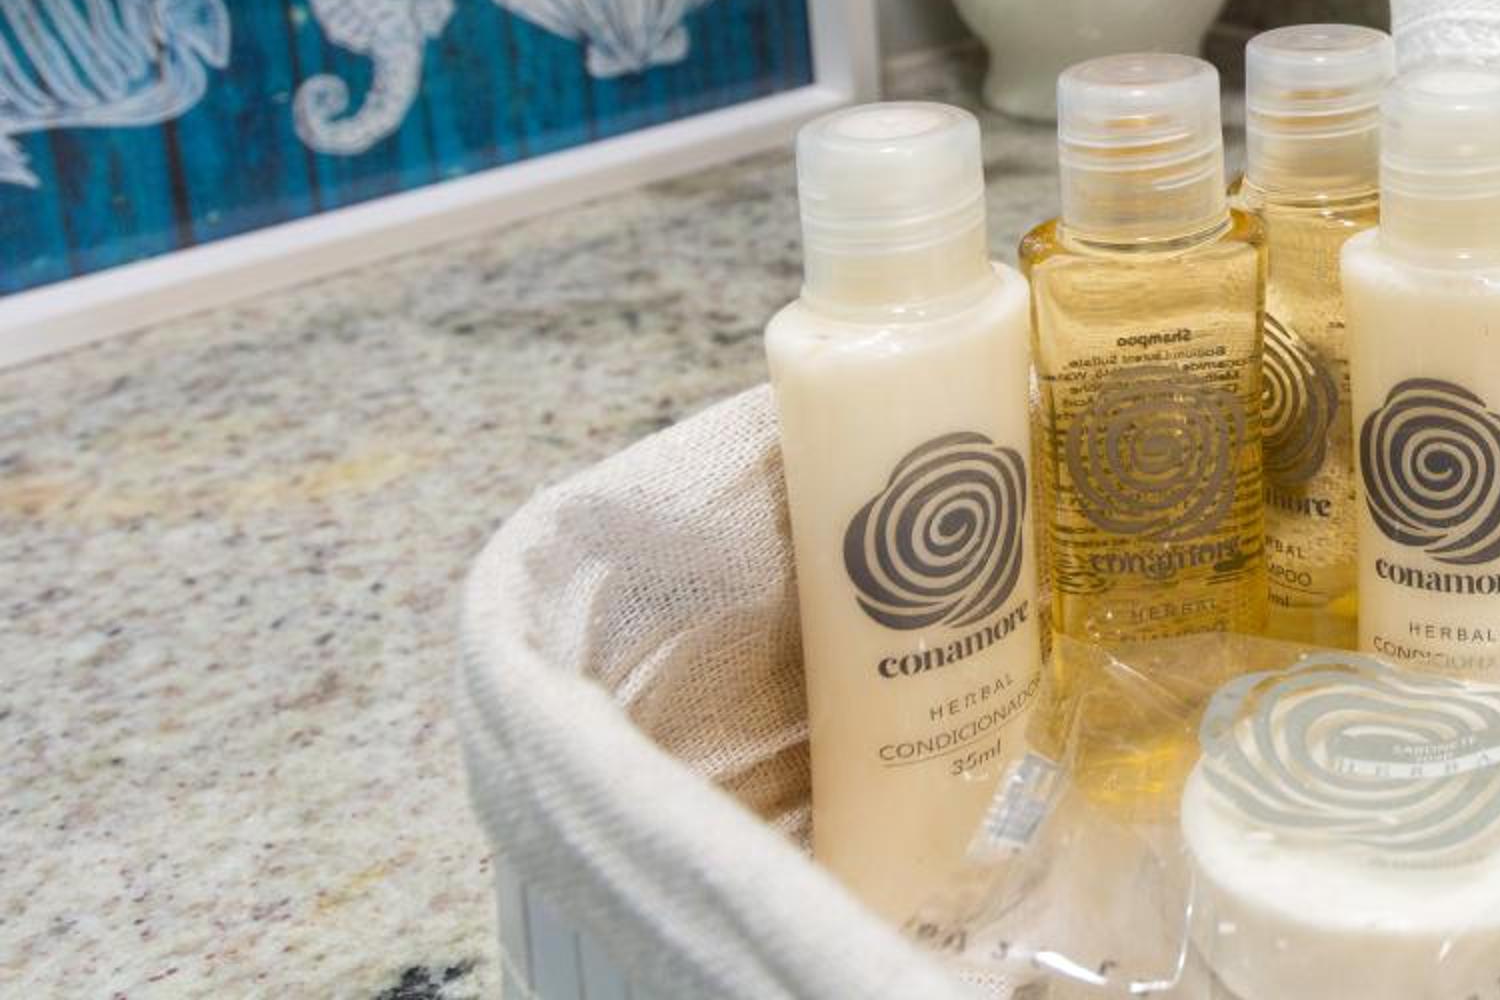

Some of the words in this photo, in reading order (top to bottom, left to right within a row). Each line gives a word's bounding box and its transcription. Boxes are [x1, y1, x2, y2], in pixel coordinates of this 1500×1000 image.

[1409, 621, 1498, 643] HERBAL
[929, 672, 1014, 722] HERBAL
[951, 737, 1001, 777] 35ml
